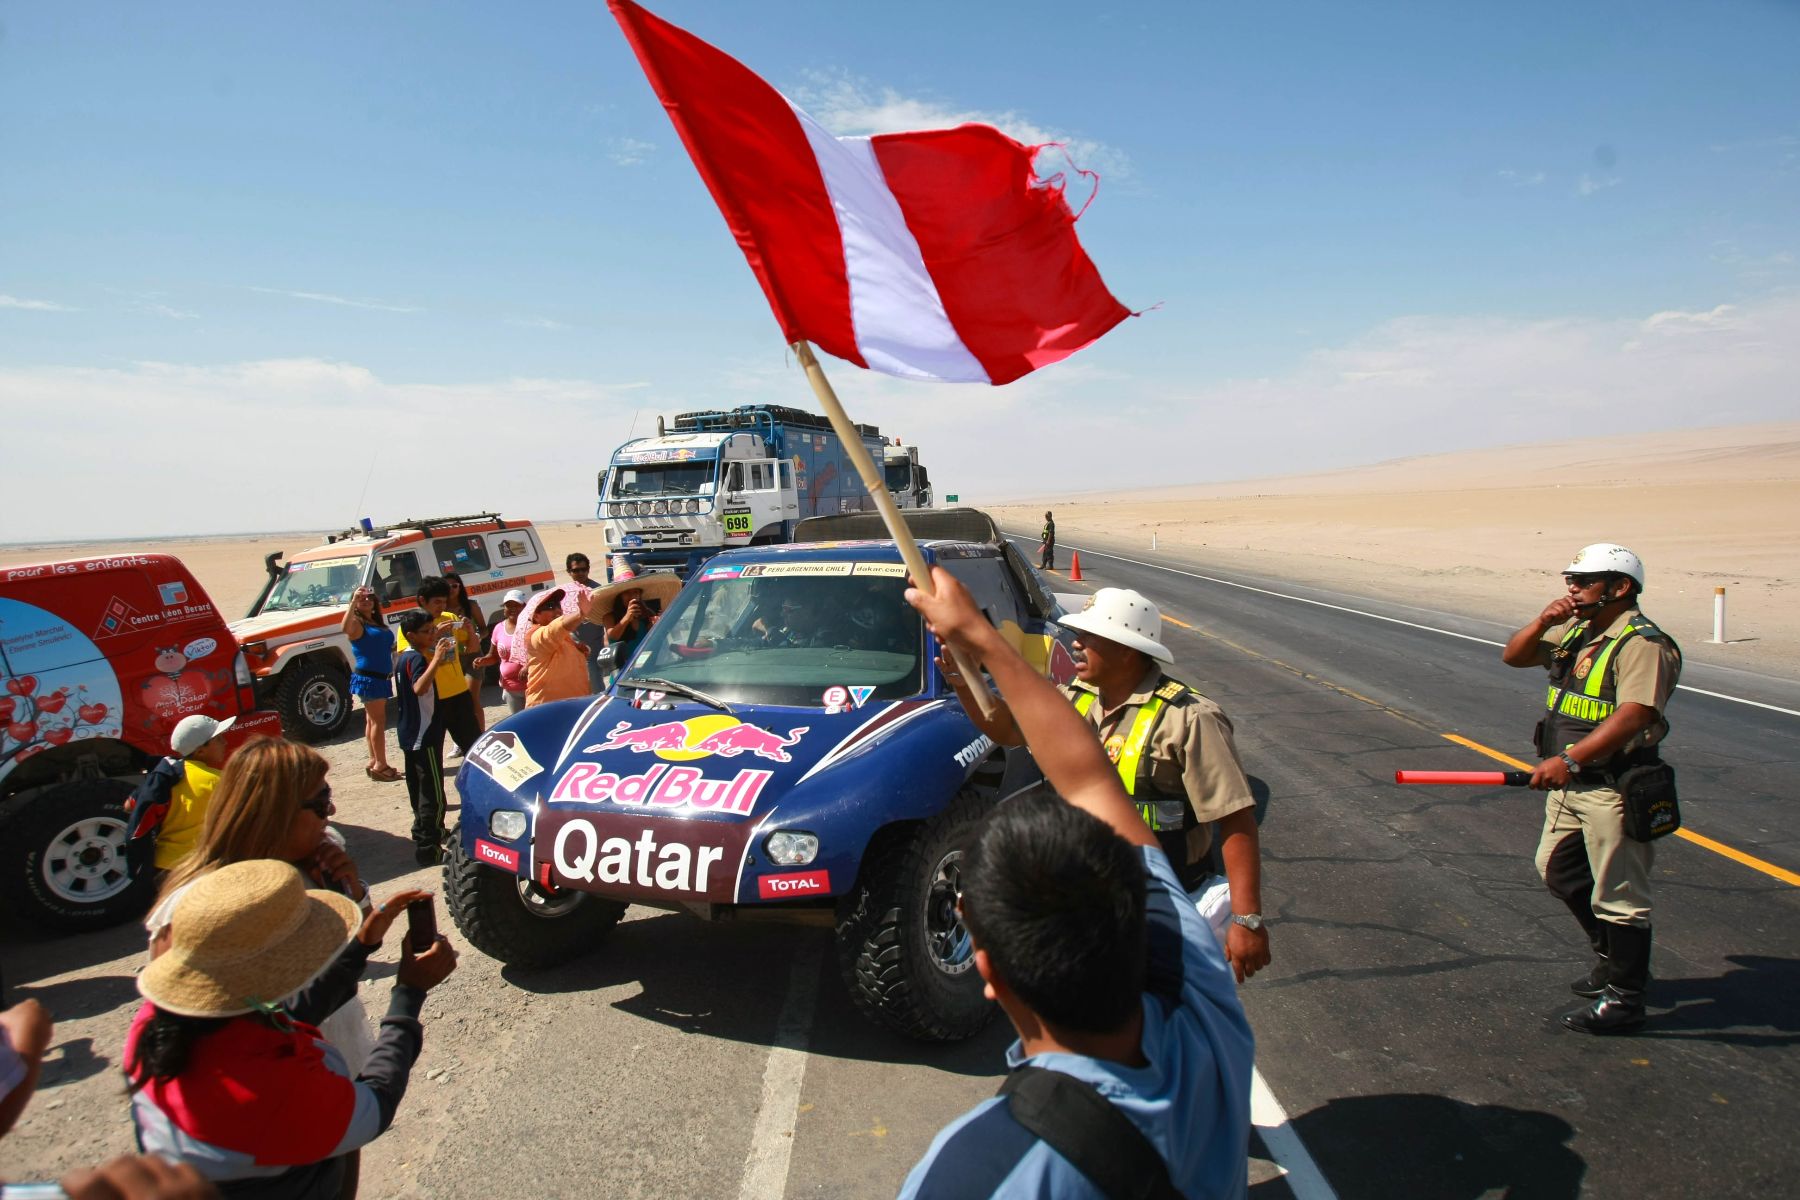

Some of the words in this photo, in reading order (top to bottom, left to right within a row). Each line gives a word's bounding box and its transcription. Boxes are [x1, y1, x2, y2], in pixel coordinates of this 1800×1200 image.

[726, 516, 749, 530] 698
[7, 566, 45, 582] pour
[51, 563, 78, 575] les
[785, 565, 824, 573] ARGENTINA
[856, 565, 905, 574] dakar.com
[130, 613, 160, 625] Centre
[184, 602, 212, 614] Berard
[180, 693, 208, 705] Dakar
[486, 744, 513, 765] 300
[549, 762, 669, 804] Red
[650, 766, 774, 816] Bull
[481, 844, 512, 865] TOTAL
[553, 818, 723, 892] Qatar
[767, 878, 820, 892] TOTAL
